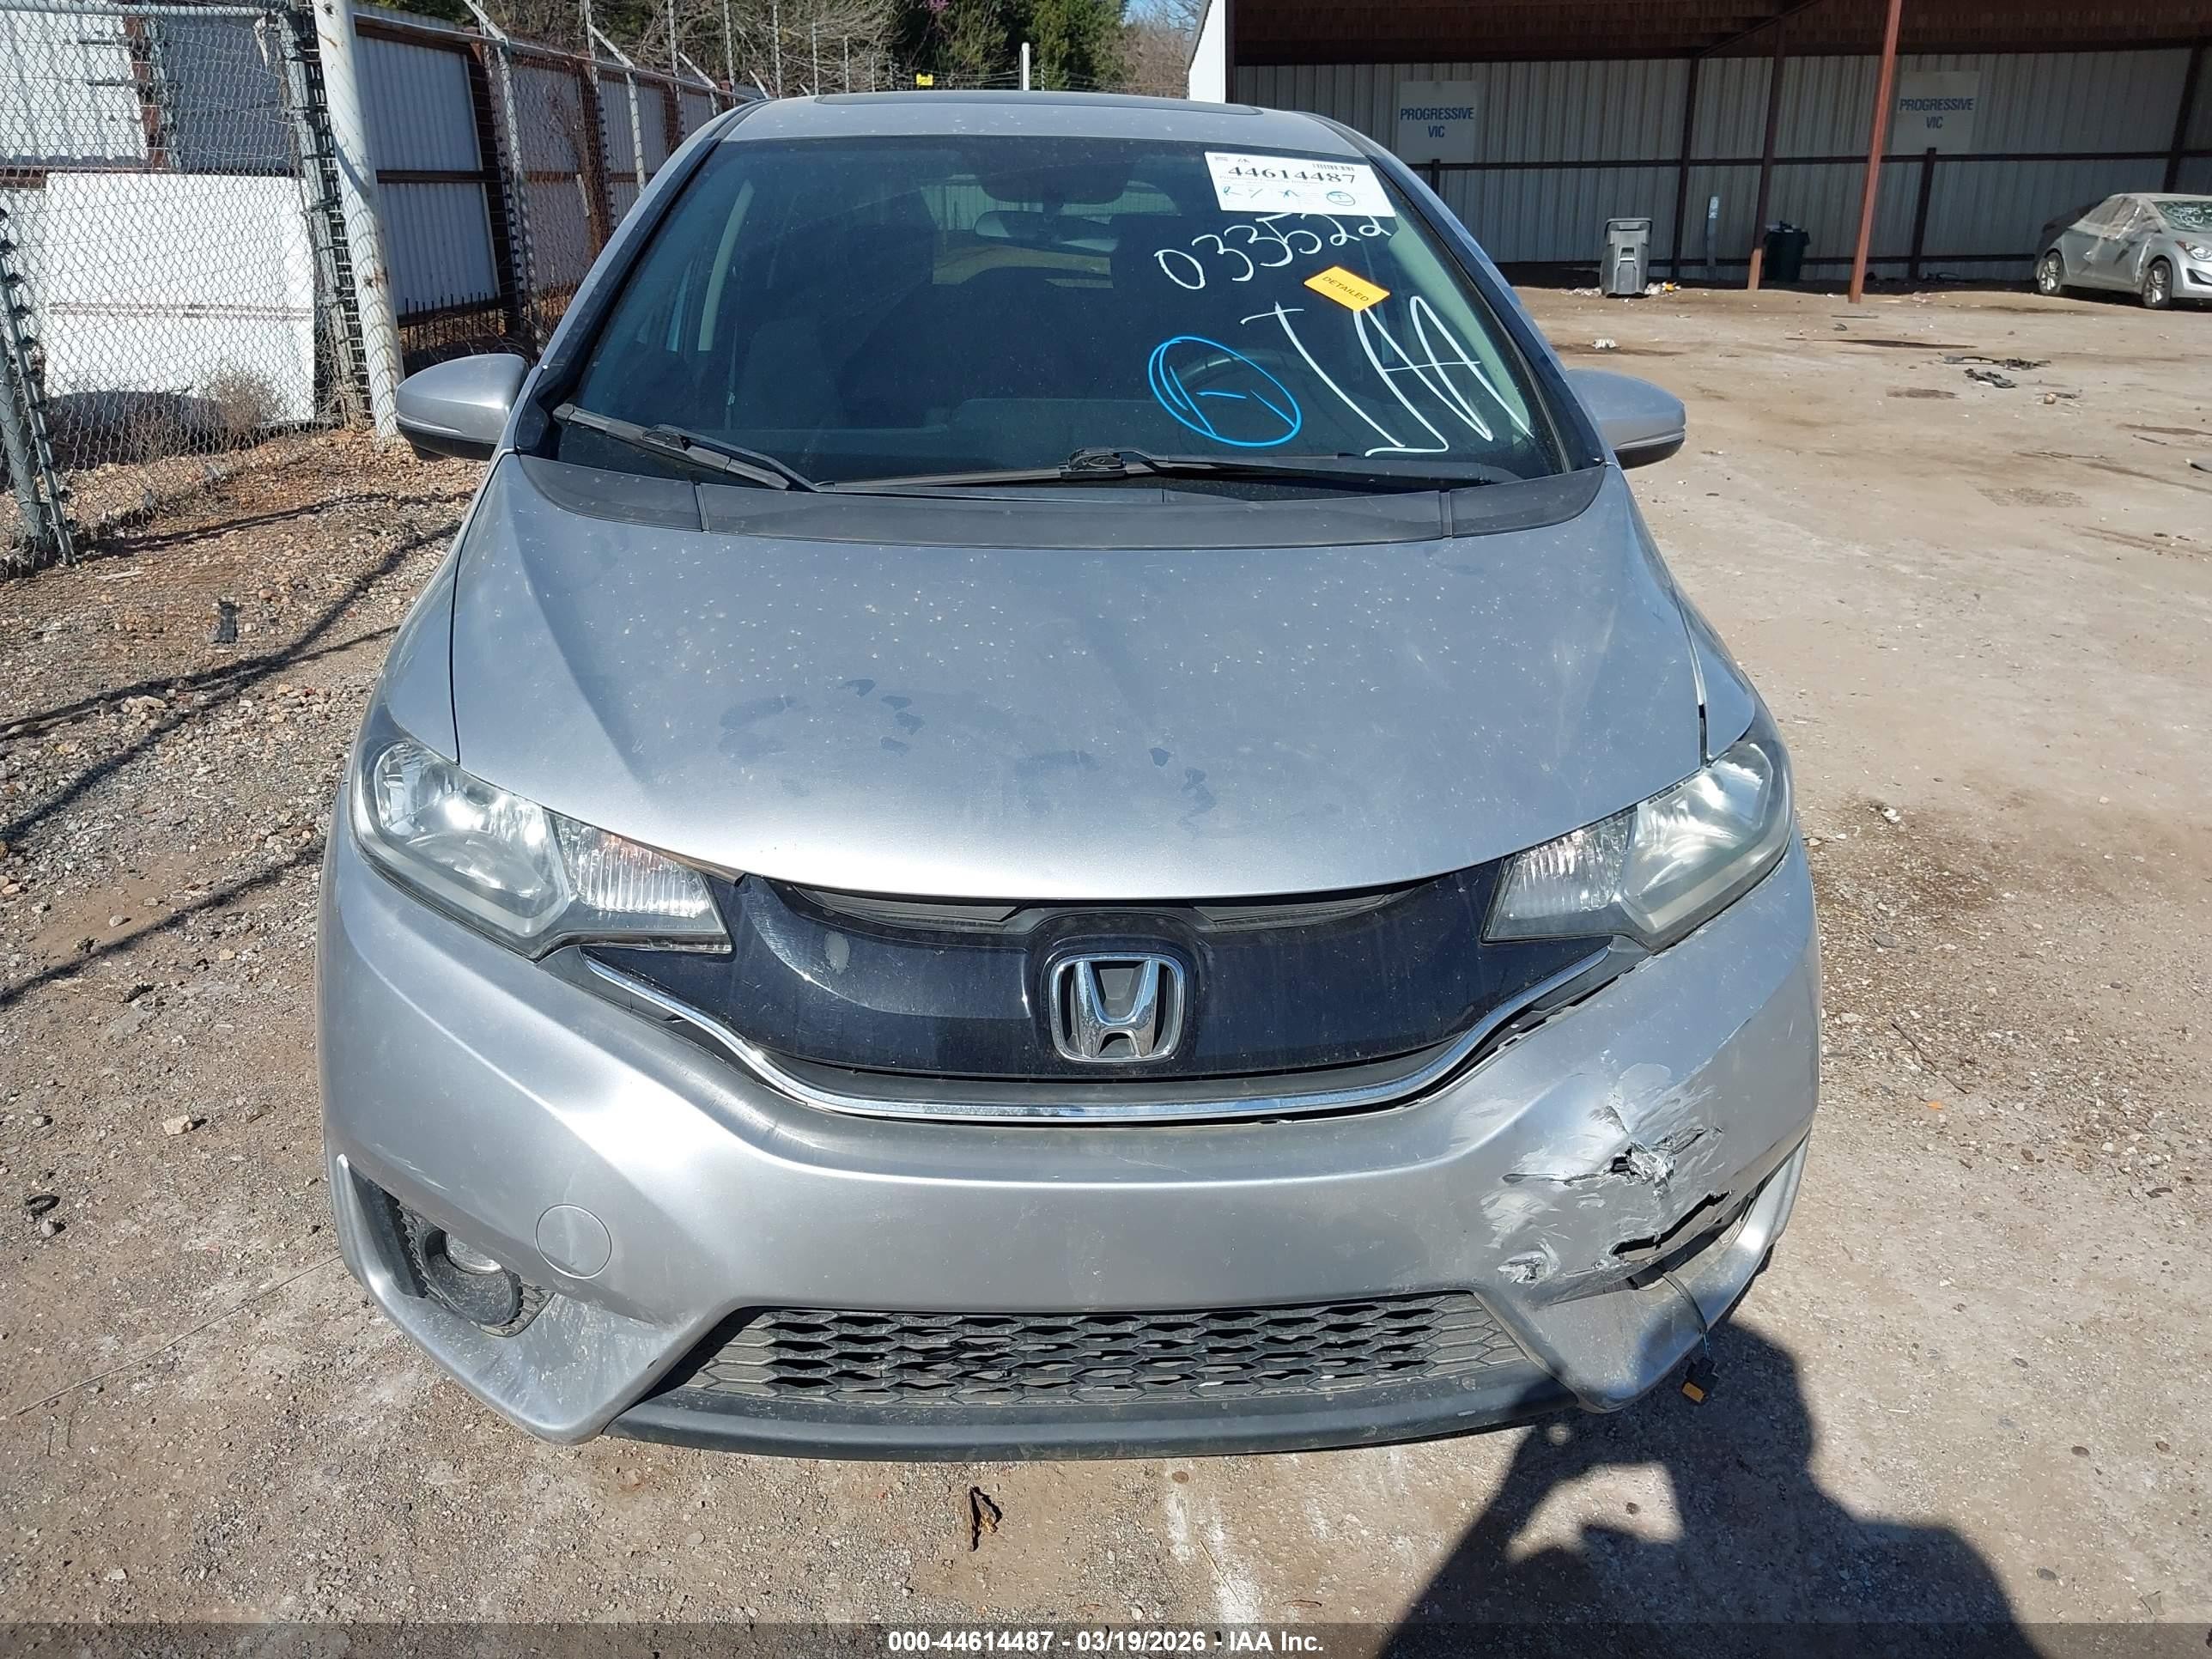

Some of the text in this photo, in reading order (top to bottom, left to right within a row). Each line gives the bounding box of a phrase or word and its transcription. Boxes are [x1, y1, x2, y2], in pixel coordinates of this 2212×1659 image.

[1899, 99, 1974, 111] PROGRESSIVE
[1401, 107, 1474, 120] PROGRESSIVE
[1926, 116, 1943, 129] VIC
[1428, 125, 1445, 138] VIC
[1228, 166, 1356, 184] 44614487
[1322, 276, 1370, 301] DETAILED
